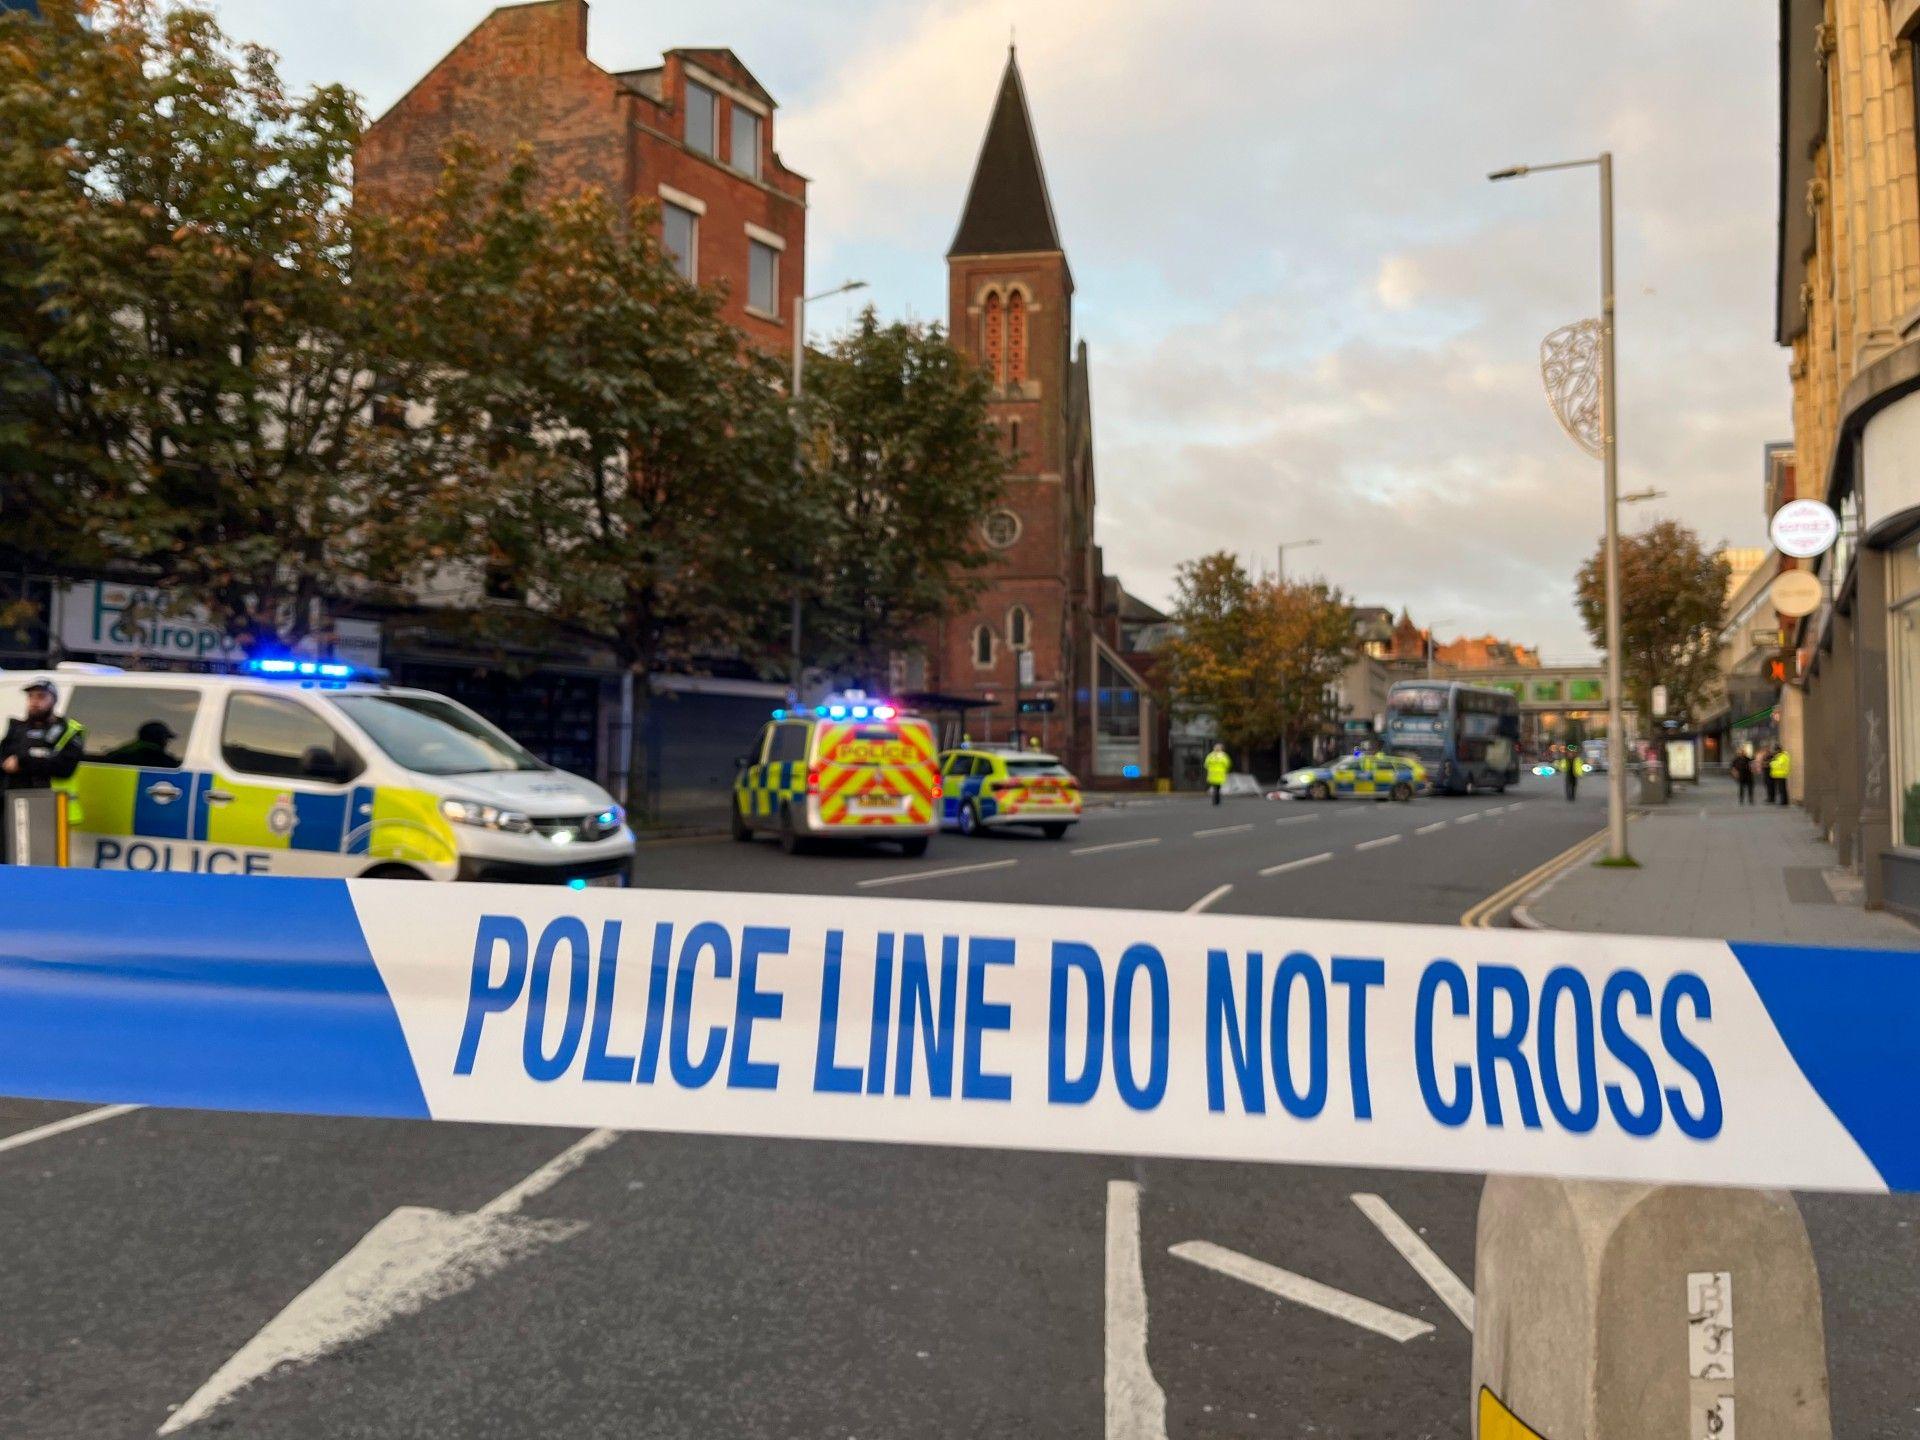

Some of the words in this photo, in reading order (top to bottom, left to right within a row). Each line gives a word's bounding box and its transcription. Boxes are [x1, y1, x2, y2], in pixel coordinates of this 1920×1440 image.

[453, 914, 791, 1090] POLICE
[813, 929, 1016, 1103] LINE
[1048, 941, 1170, 1111] DO
[1206, 948, 1385, 1121] NOT
[1415, 959, 1723, 1142] CROSS
